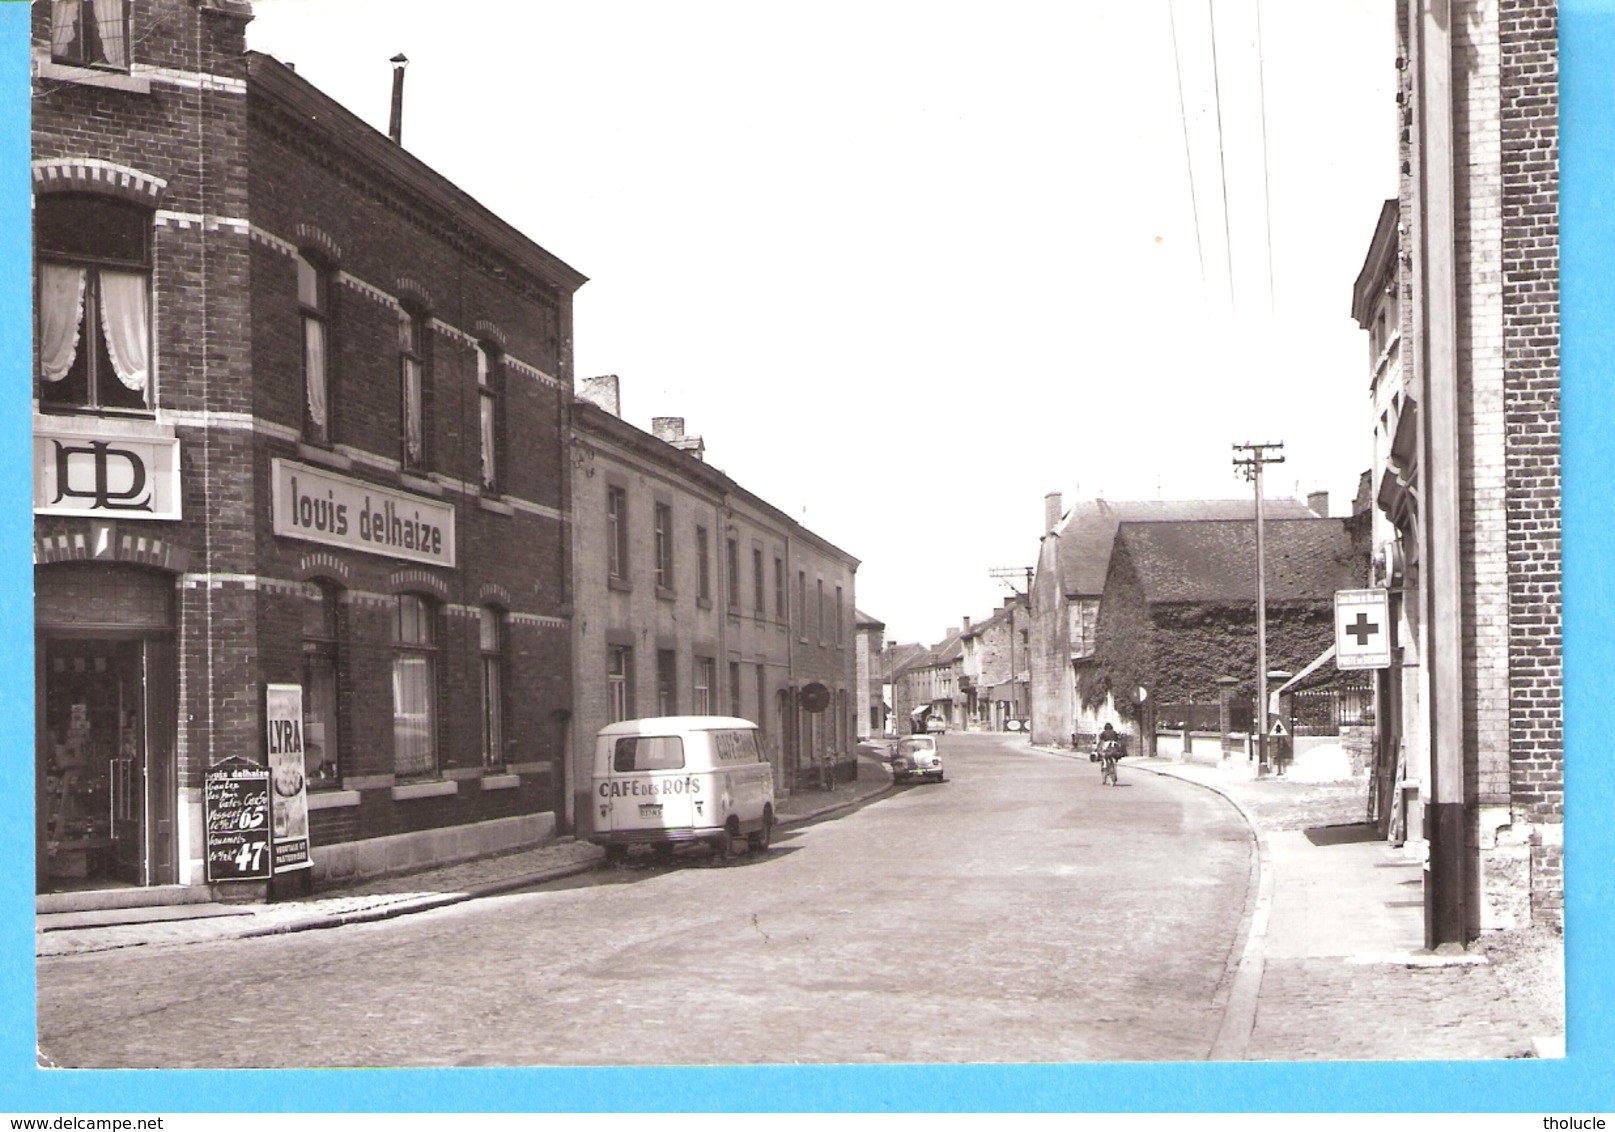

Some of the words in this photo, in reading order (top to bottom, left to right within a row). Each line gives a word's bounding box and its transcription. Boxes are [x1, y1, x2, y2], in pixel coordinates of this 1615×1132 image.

[291, 476, 348, 536] louis
[360, 496, 442, 555] delhaize
[269, 719, 302, 754] LYRA
[232, 768, 270, 779] delhaize
[641, 784, 660, 796] DES
[662, 777, 701, 795] ROIS
[239, 805, 264, 829] 65
[235, 841, 266, 871] 47
